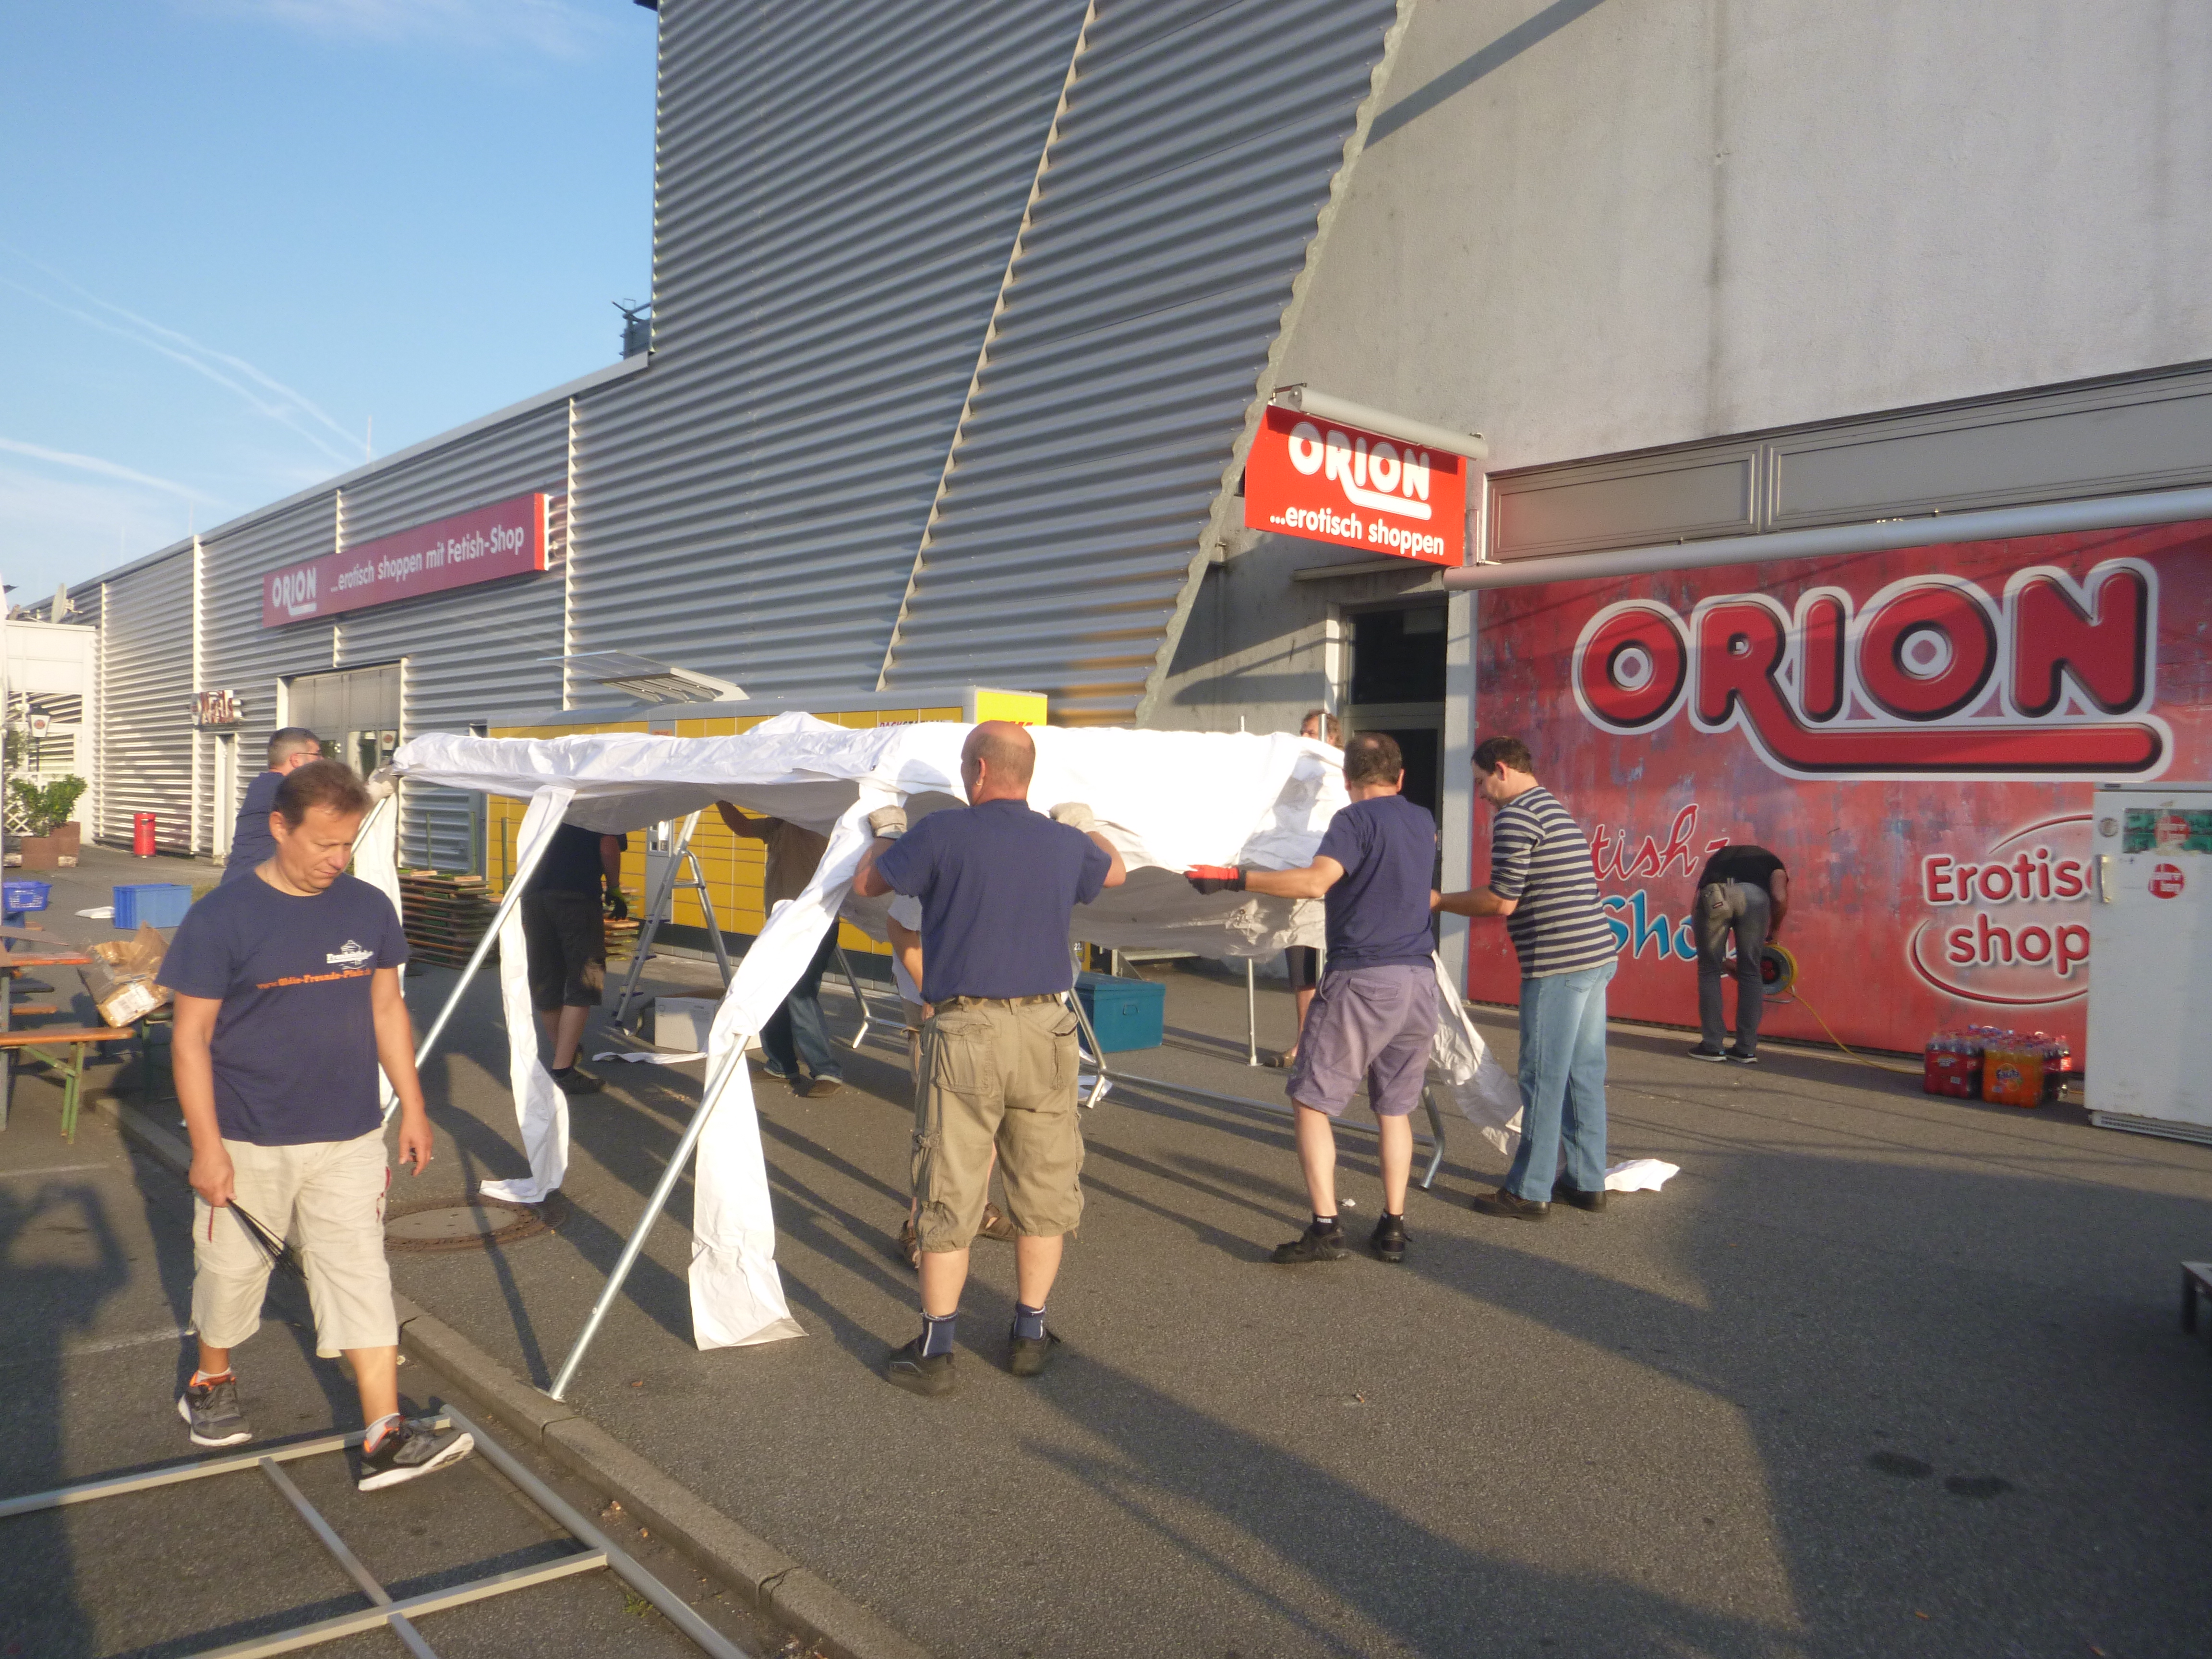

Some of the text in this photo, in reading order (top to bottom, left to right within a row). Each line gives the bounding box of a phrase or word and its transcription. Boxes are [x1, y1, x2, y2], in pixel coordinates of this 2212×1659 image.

[1288, 421, 1431, 520] ORION
[272, 565, 317, 616] ORION
[378, 554, 422, 583] shoppen
[426, 541, 445, 569] mit
[447, 525, 524, 564] Fetish-Shop
[1270, 505, 1444, 556] ...erotisch shoppen
[1572, 557, 2174, 781] ORION
[1590, 803, 1730, 881] tish-
[1600, 889, 1709, 962] Sho
